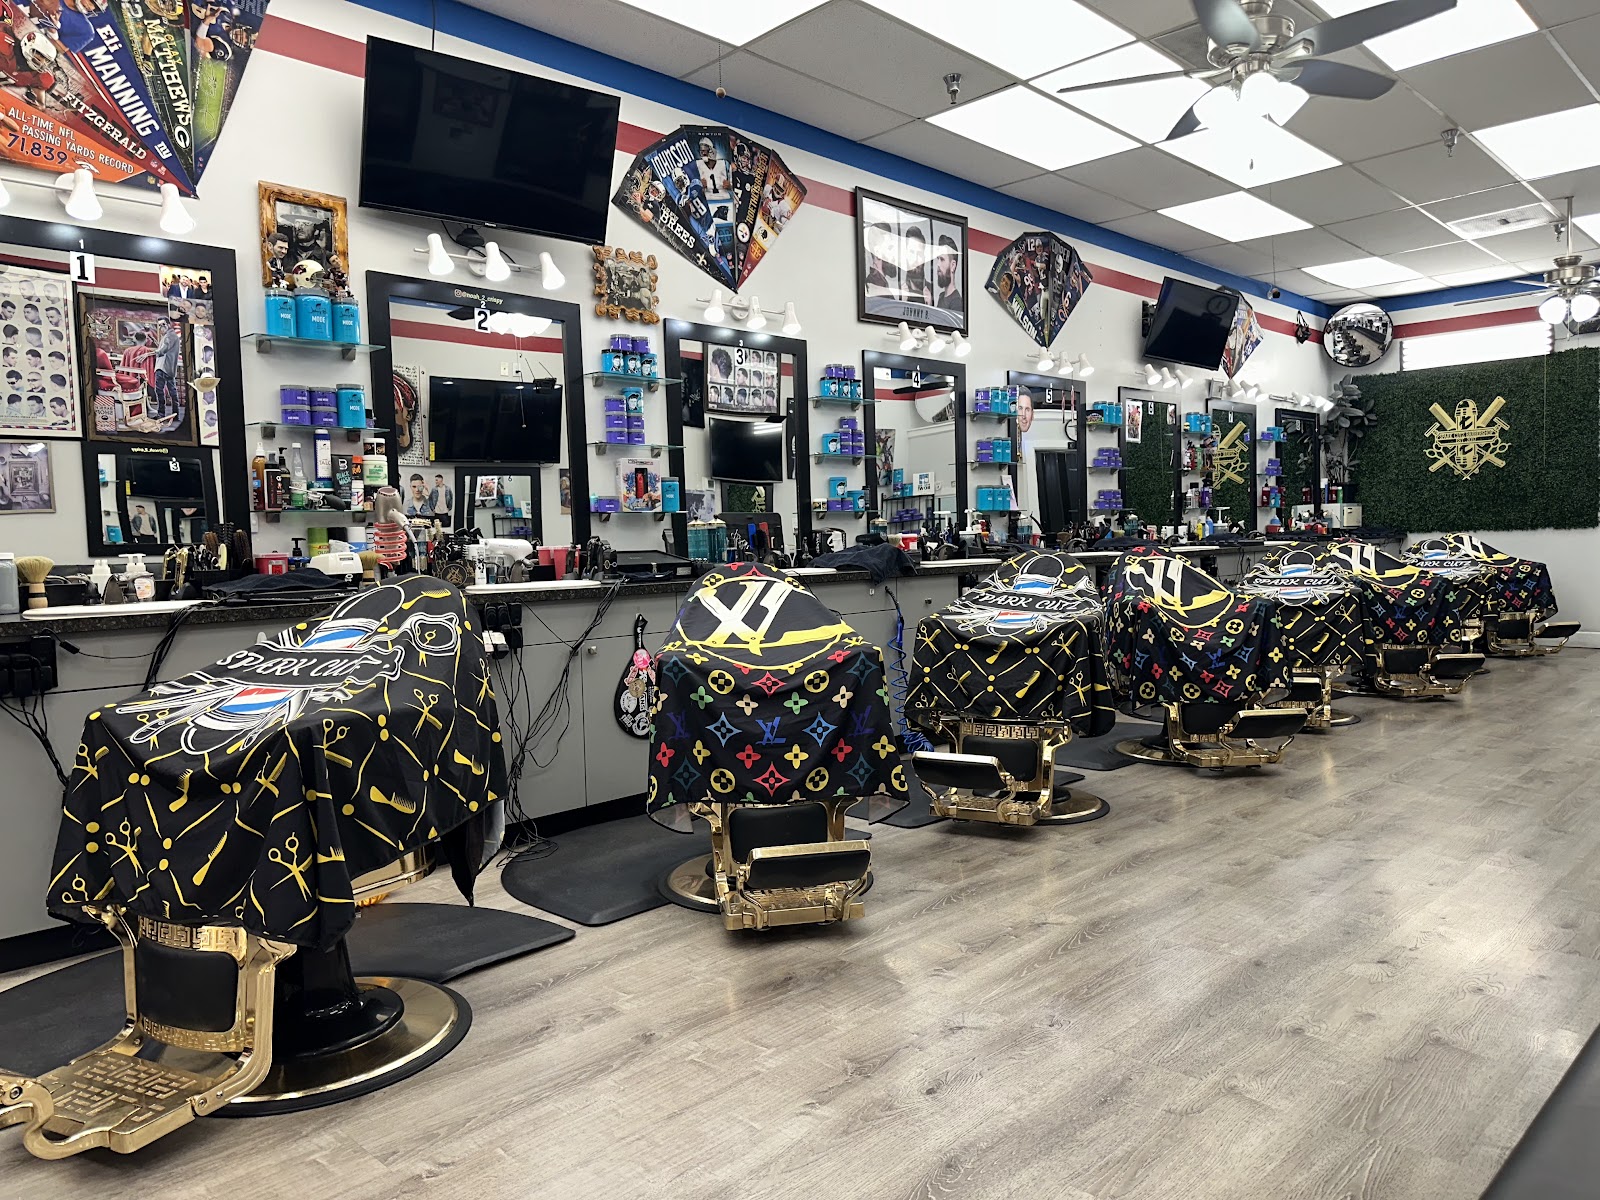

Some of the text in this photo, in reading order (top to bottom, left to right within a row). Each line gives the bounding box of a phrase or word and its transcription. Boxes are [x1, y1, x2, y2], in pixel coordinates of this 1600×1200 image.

[97, 24, 122, 53] Eli
[164, 34, 183, 65] CLAY
[143, 19, 192, 126] MATTHEWS
[85, 45, 159, 137] MANNING
[8, 107, 76, 141] ALL-TIME NFL
[63, 91, 147, 160] FITZGERALD
[7, 132, 68, 165] 71,839
[21, 125, 135, 174] PASSING YARDS RECORD
[78, 239, 84, 249] 1
[660, 211, 696, 249] BREES
[76, 255, 89, 280] 1
[312, 315, 326, 323] MODE
[477, 310, 488, 330] 2
[902, 306, 924, 317] JOHNNY
[1012, 297, 1038, 340] WILSON
[736, 348, 744, 365] 3
[913, 372, 920, 386] 4
[1047, 391, 1052, 402] 5
